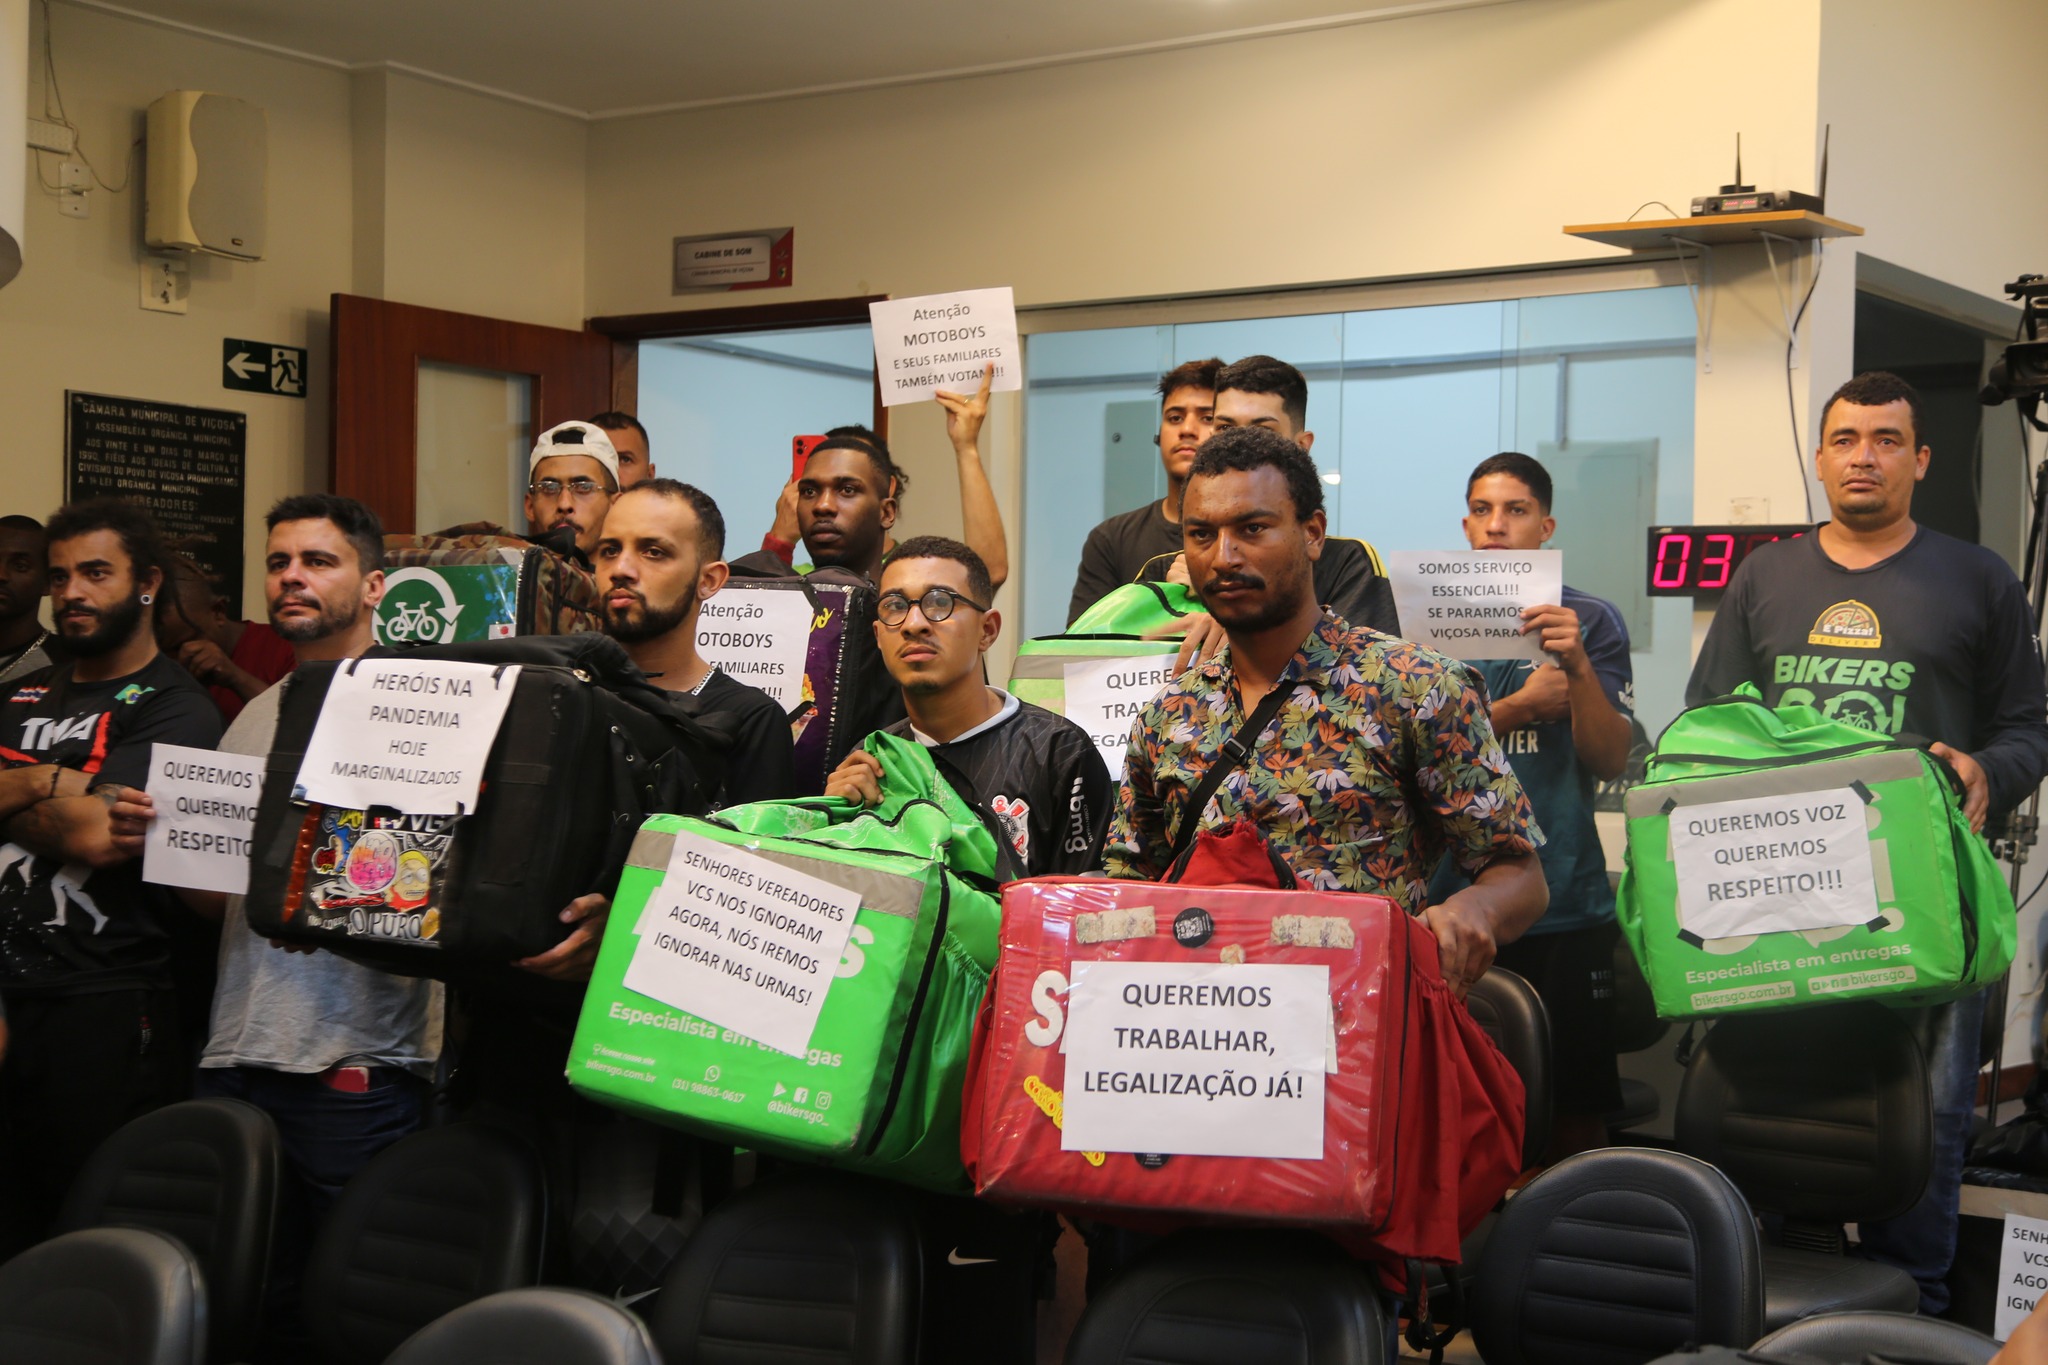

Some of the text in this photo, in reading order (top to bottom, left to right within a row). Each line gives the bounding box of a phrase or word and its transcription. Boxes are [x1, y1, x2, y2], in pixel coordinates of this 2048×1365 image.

[694, 247, 752, 259] CABINE DE SOM
[913, 303, 971, 321] Atenção
[904, 325, 986, 347] MOTOBOYS
[893, 347, 1001, 370] E SEUS FAMILIARES
[895, 371, 945, 389] TAMBÉM
[82, 400, 125, 417] CÂMARA
[131, 407, 179, 425] MUNICIPAL
[185, 415, 197, 427] DE
[85, 438, 101, 448] AOS
[105, 440, 128, 451] VINTE
[160, 446, 178, 456] DIAS
[184, 448, 192, 458] DE
[193, 433, 232, 447] MUNICIPAL
[78, 462, 112, 474] CIVISMO
[113, 465, 124, 475] DO
[126, 467, 146, 478] POVO
[148, 469, 156, 479] DE
[131, 456, 147, 466] AOS
[196, 462, 229, 474] CULTURA
[78, 475, 84, 484] A
[1418, 562, 1532, 576] SOMOS SERVIÇO
[1432, 584, 1519, 597] ESSENCIAL!!!
[699, 602, 764, 621] Atenção
[1428, 607, 1443, 618] SE
[1430, 628, 1481, 640] VIÇOSA
[1810, 636, 1879, 646] DELIVERY
[1834, 624, 1874, 637] Pizza!
[372, 672, 473, 698] HERÓIS NA
[1774, 655, 1916, 691] BIKERS
[369, 705, 461, 729] PANDEMIA
[388, 739, 428, 757] HOJE
[164, 761, 253, 789] QUEREMOS
[330, 761, 462, 785] MARGINALIZADOS
[1065, 795, 1088, 854] bmg
[1688, 804, 1847, 837] QUEREMOS VOZ
[1714, 838, 1827, 866] QUEREMOS
[684, 851, 845, 922] SENHORES VEREADORES
[1707, 869, 1843, 902] RESPEITO!!!
[687, 880, 823, 945] VCS NOS IGNORAM
[668, 905, 722, 940] AGORA,
[726, 926, 758, 951] NÓS
[760, 940, 820, 975] IREMOS
[653, 932, 812, 1006] IGNORAR NAS URNAS!
[1685, 943, 1912, 985] Especialista em entregas
[1122, 983, 1272, 1008] QUEREMOS
[1694, 968, 1915, 1008] bikersgo.com.br bikersgo_
[608, 1001, 717, 1039] Especialista
[1114, 1027, 1276, 1056] TRABALHAR,
[584, 1058, 657, 1084] bikersgo.com.br
[672, 1077, 690, 1093] (31)
[1083, 1069, 1303, 1102] LEGALIZAÇÃO JÁ!
[767, 1100, 829, 1127] @bikersgo_
